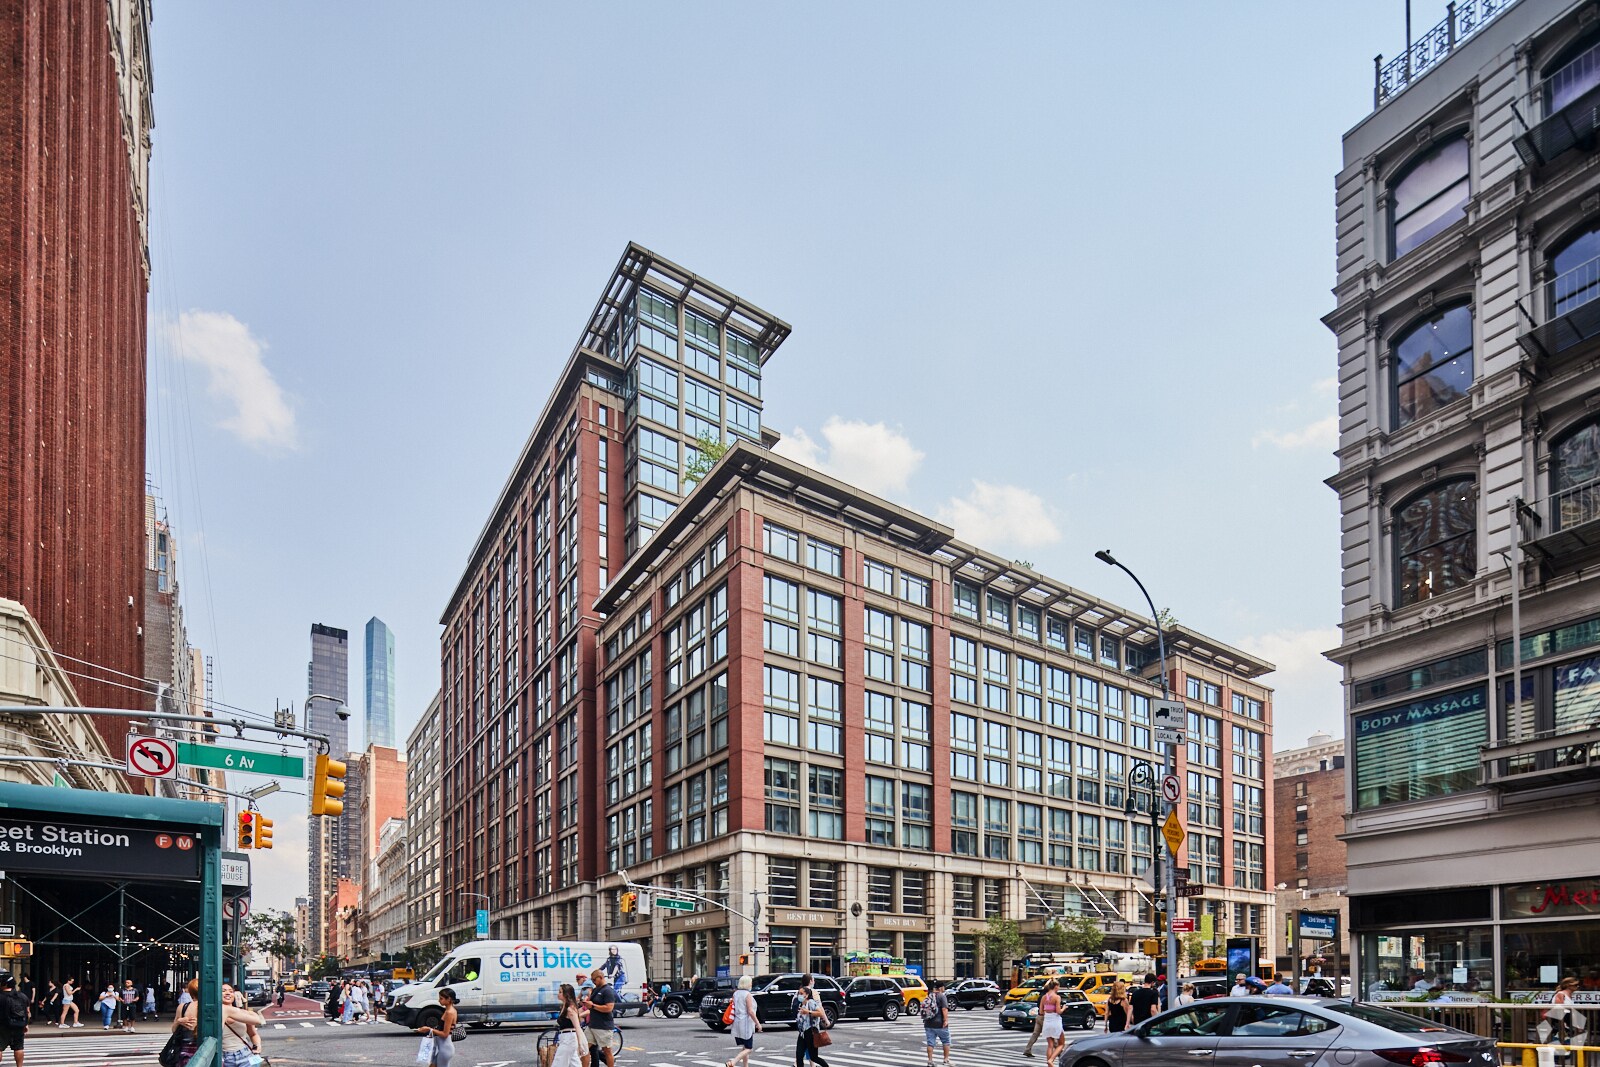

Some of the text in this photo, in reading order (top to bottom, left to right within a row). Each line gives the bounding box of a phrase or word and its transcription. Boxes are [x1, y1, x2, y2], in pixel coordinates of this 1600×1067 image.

[1568, 666, 1600, 682] FA
[1170, 706, 1184, 714] TRUCK
[1361, 694, 1480, 731] BODY MASSAGE
[1170, 715, 1184, 723] ROUTE
[1157, 732, 1173, 740] LOCAL
[225, 753, 255, 769] 6 Av
[42, 825, 130, 847] Station
[159, 836, 191, 848] F M
[0, 841, 82, 857] & Brooklyn
[221, 872, 243, 880] HOUSE
[786, 913, 806, 921] BEST
[884, 918, 917, 927] BEST BUY
[499, 946, 592, 969] citi bike
[1536, 993, 1549, 1001] WE
[1585, 993, 1592, 1001] &
